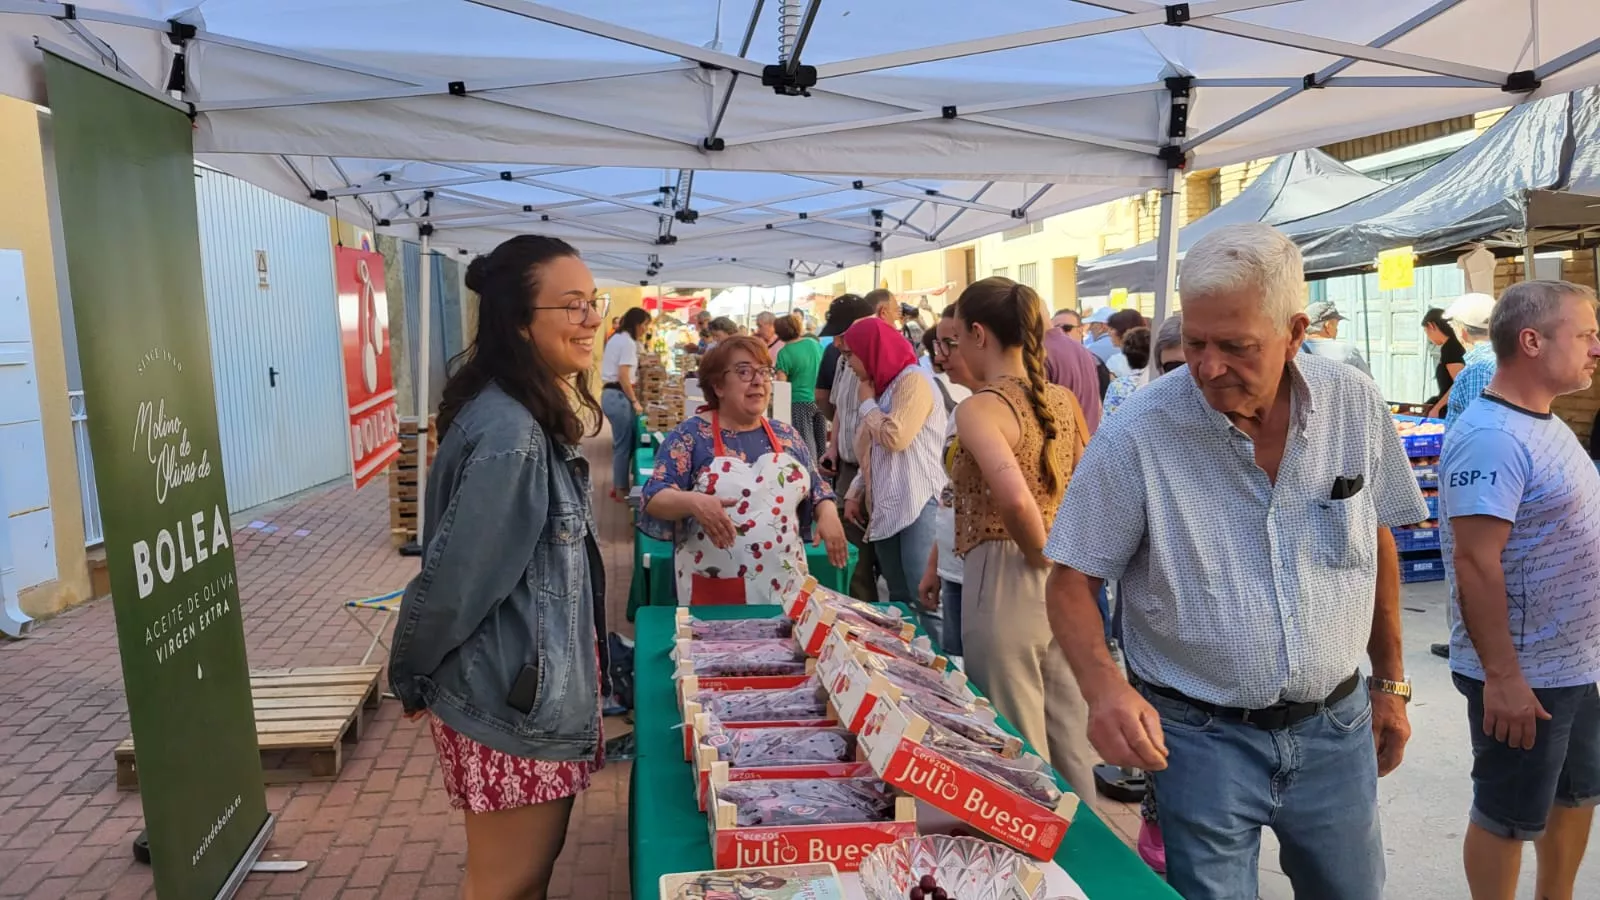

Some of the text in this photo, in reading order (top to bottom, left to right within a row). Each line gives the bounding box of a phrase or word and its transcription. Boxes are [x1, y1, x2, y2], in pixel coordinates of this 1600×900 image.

[132, 398, 181, 464] Molino
[179, 427, 192, 457] de
[156, 442, 211, 504] Olivas de
[1450, 470, 1497, 488] ESP-1
[132, 503, 230, 599] BOLEA
[145, 571, 234, 645] ACEITE DE OLIVA
[156, 598, 230, 665] VIRGEN EXTRA
[894, 756, 959, 801] Julio
[963, 787, 1037, 841] Buesa
[736, 838, 873, 869] Julio Bues
